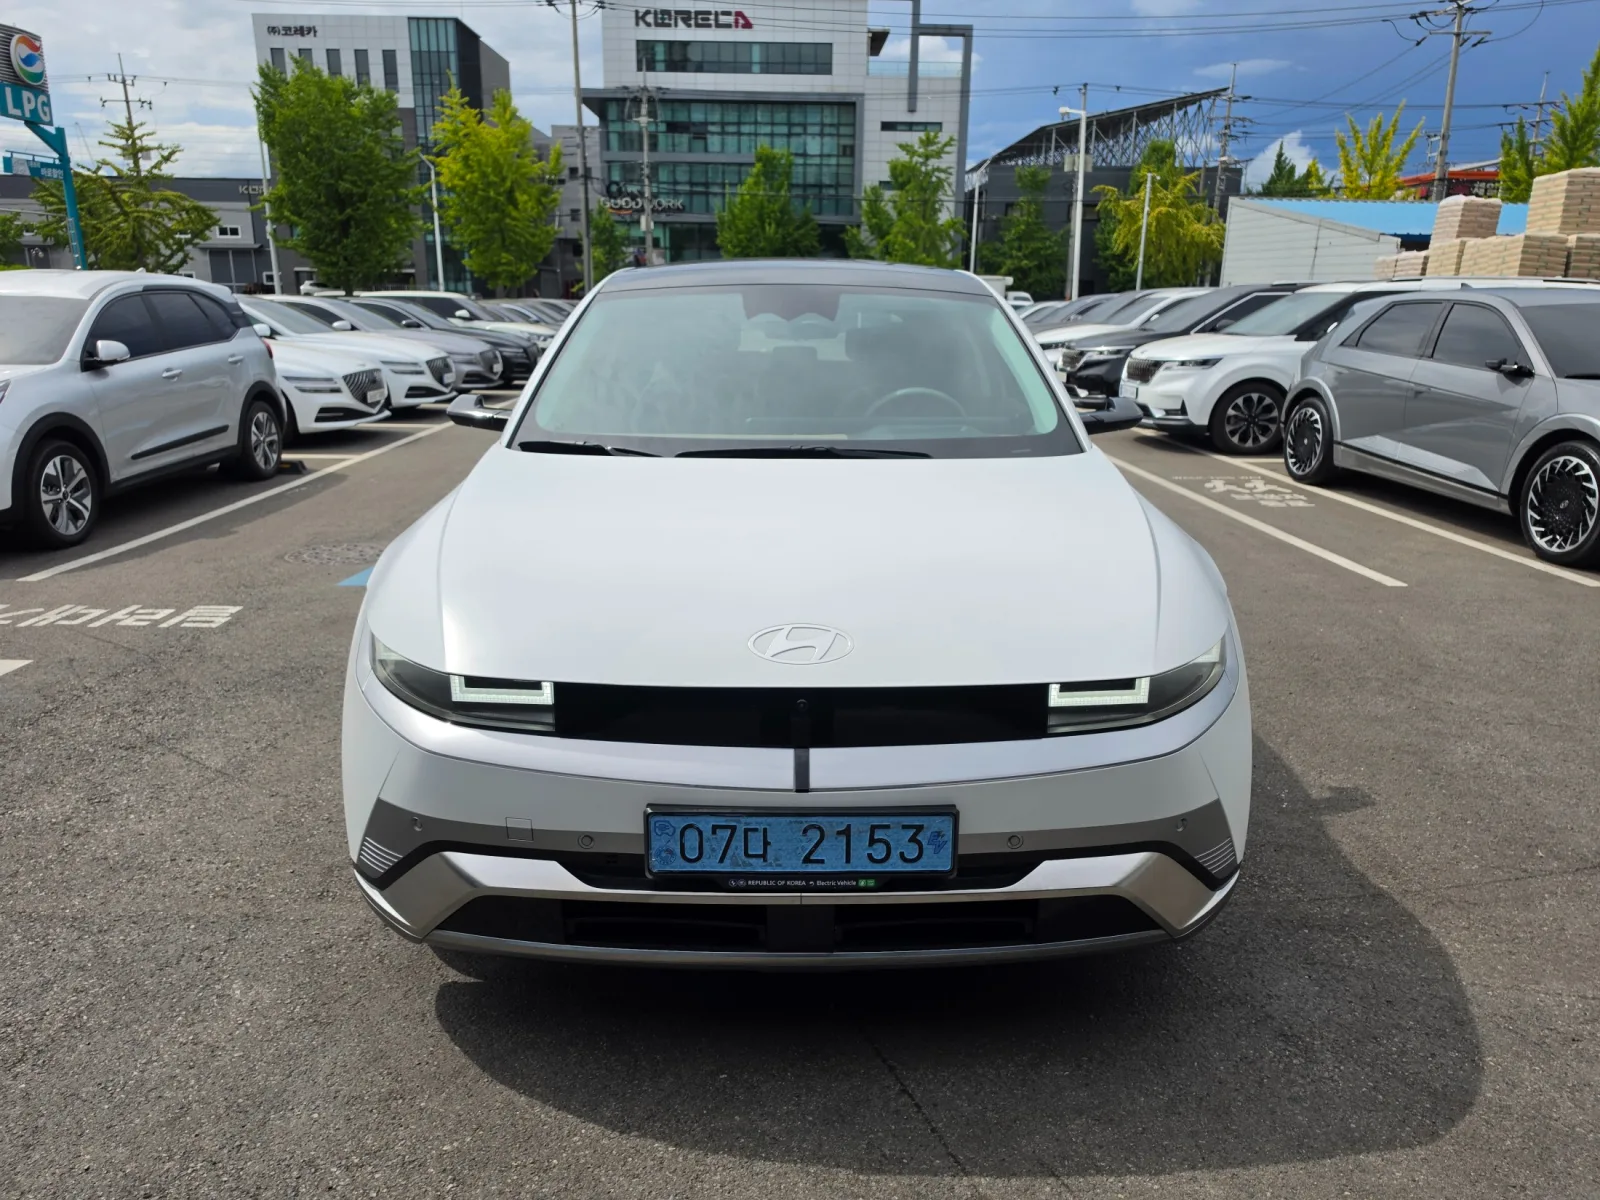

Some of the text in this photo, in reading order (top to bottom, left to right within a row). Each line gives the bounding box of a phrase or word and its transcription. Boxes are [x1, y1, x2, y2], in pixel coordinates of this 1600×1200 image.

[634, 9, 754, 29] KORECA
[4, 86, 51, 122] LPG
[679, 823, 771, 865] 07다
[801, 823, 925, 865] 2153
[747, 879, 806, 887] REPUBLIC OF KOREA
[816, 879, 836, 887] Electric
[837, 879, 857, 887] Vehicle
